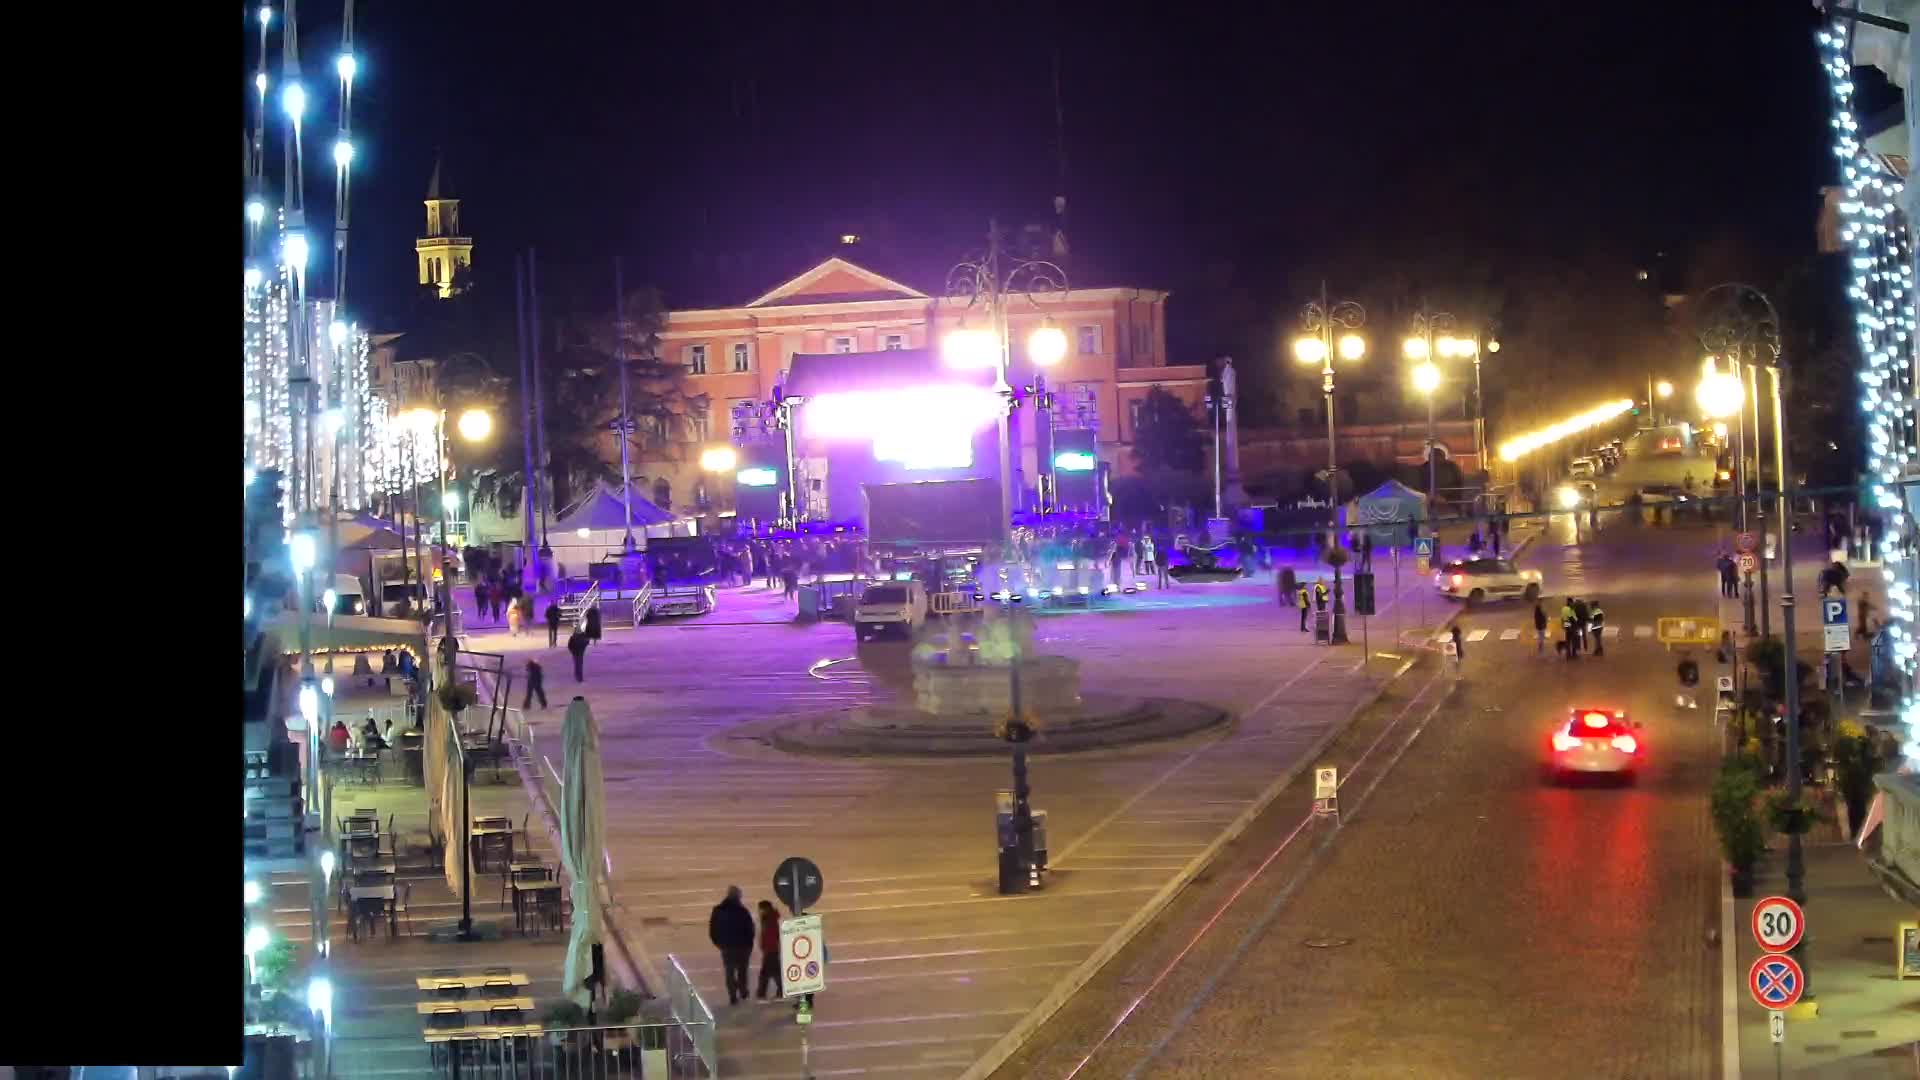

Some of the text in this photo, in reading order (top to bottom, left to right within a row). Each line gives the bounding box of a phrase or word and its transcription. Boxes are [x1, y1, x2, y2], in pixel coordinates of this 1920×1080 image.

[1743, 558, 1753, 566] 20
[1827, 603, 1842, 622] P
[1763, 912, 1791, 938] 30
